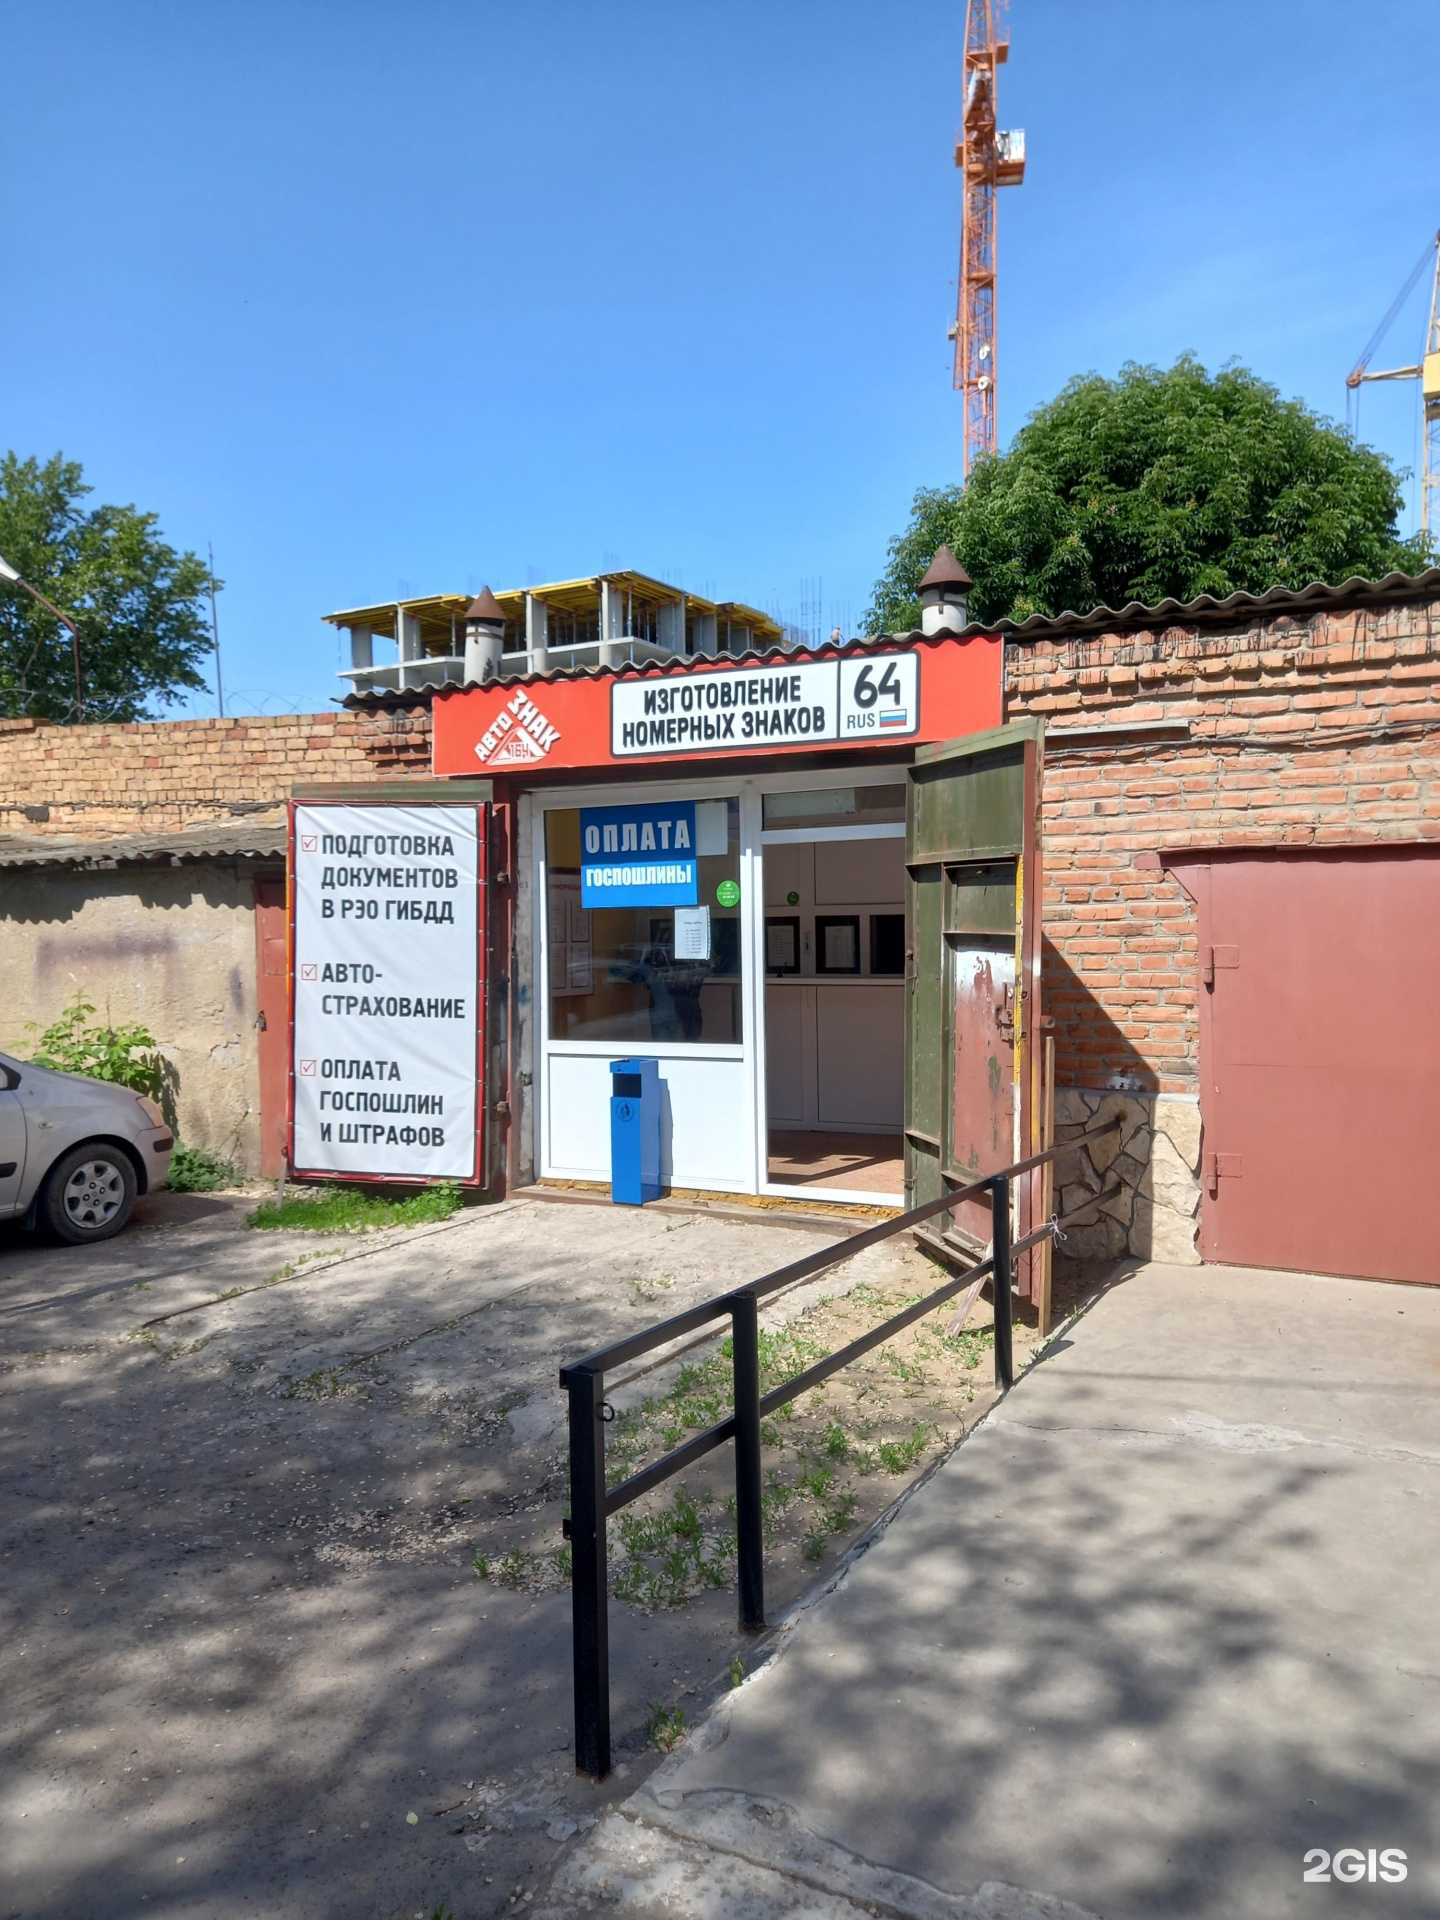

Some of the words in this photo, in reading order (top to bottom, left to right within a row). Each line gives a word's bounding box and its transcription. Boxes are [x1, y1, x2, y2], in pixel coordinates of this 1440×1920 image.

[643, 675, 801, 715] ИЗГОТОВЛЕНИЕ
[853, 662, 901, 709] 64
[474, 711, 513, 764] АВТО
[507, 689, 561, 754] ЗНАК
[622, 714, 734, 748] НОМЕРНЫХ
[741, 706, 826, 737] ЗНАКОВ
[847, 712, 876, 729] RUS
[322, 834, 454, 857] ПОДГОТОВКА
[585, 820, 691, 854] ОПЛАТА
[321, 866, 459, 890] ДОКУМЕНТОВ
[586, 864, 692, 887] ГОСПОШЛИНЫ
[322, 899, 334, 918] В
[341, 899, 379, 919] РЭО
[385, 900, 454, 925] ГИБДД
[321, 964, 383, 983] АВТО-
[322, 995, 466, 1019] СТРАХОВАНИЕ
[321, 1059, 401, 1081] ОПЛАТА
[319, 1091, 443, 1116] ГОСПОШЛИН
[320, 1123, 332, 1143] И
[338, 1123, 445, 1147] ШТРАФОВ
